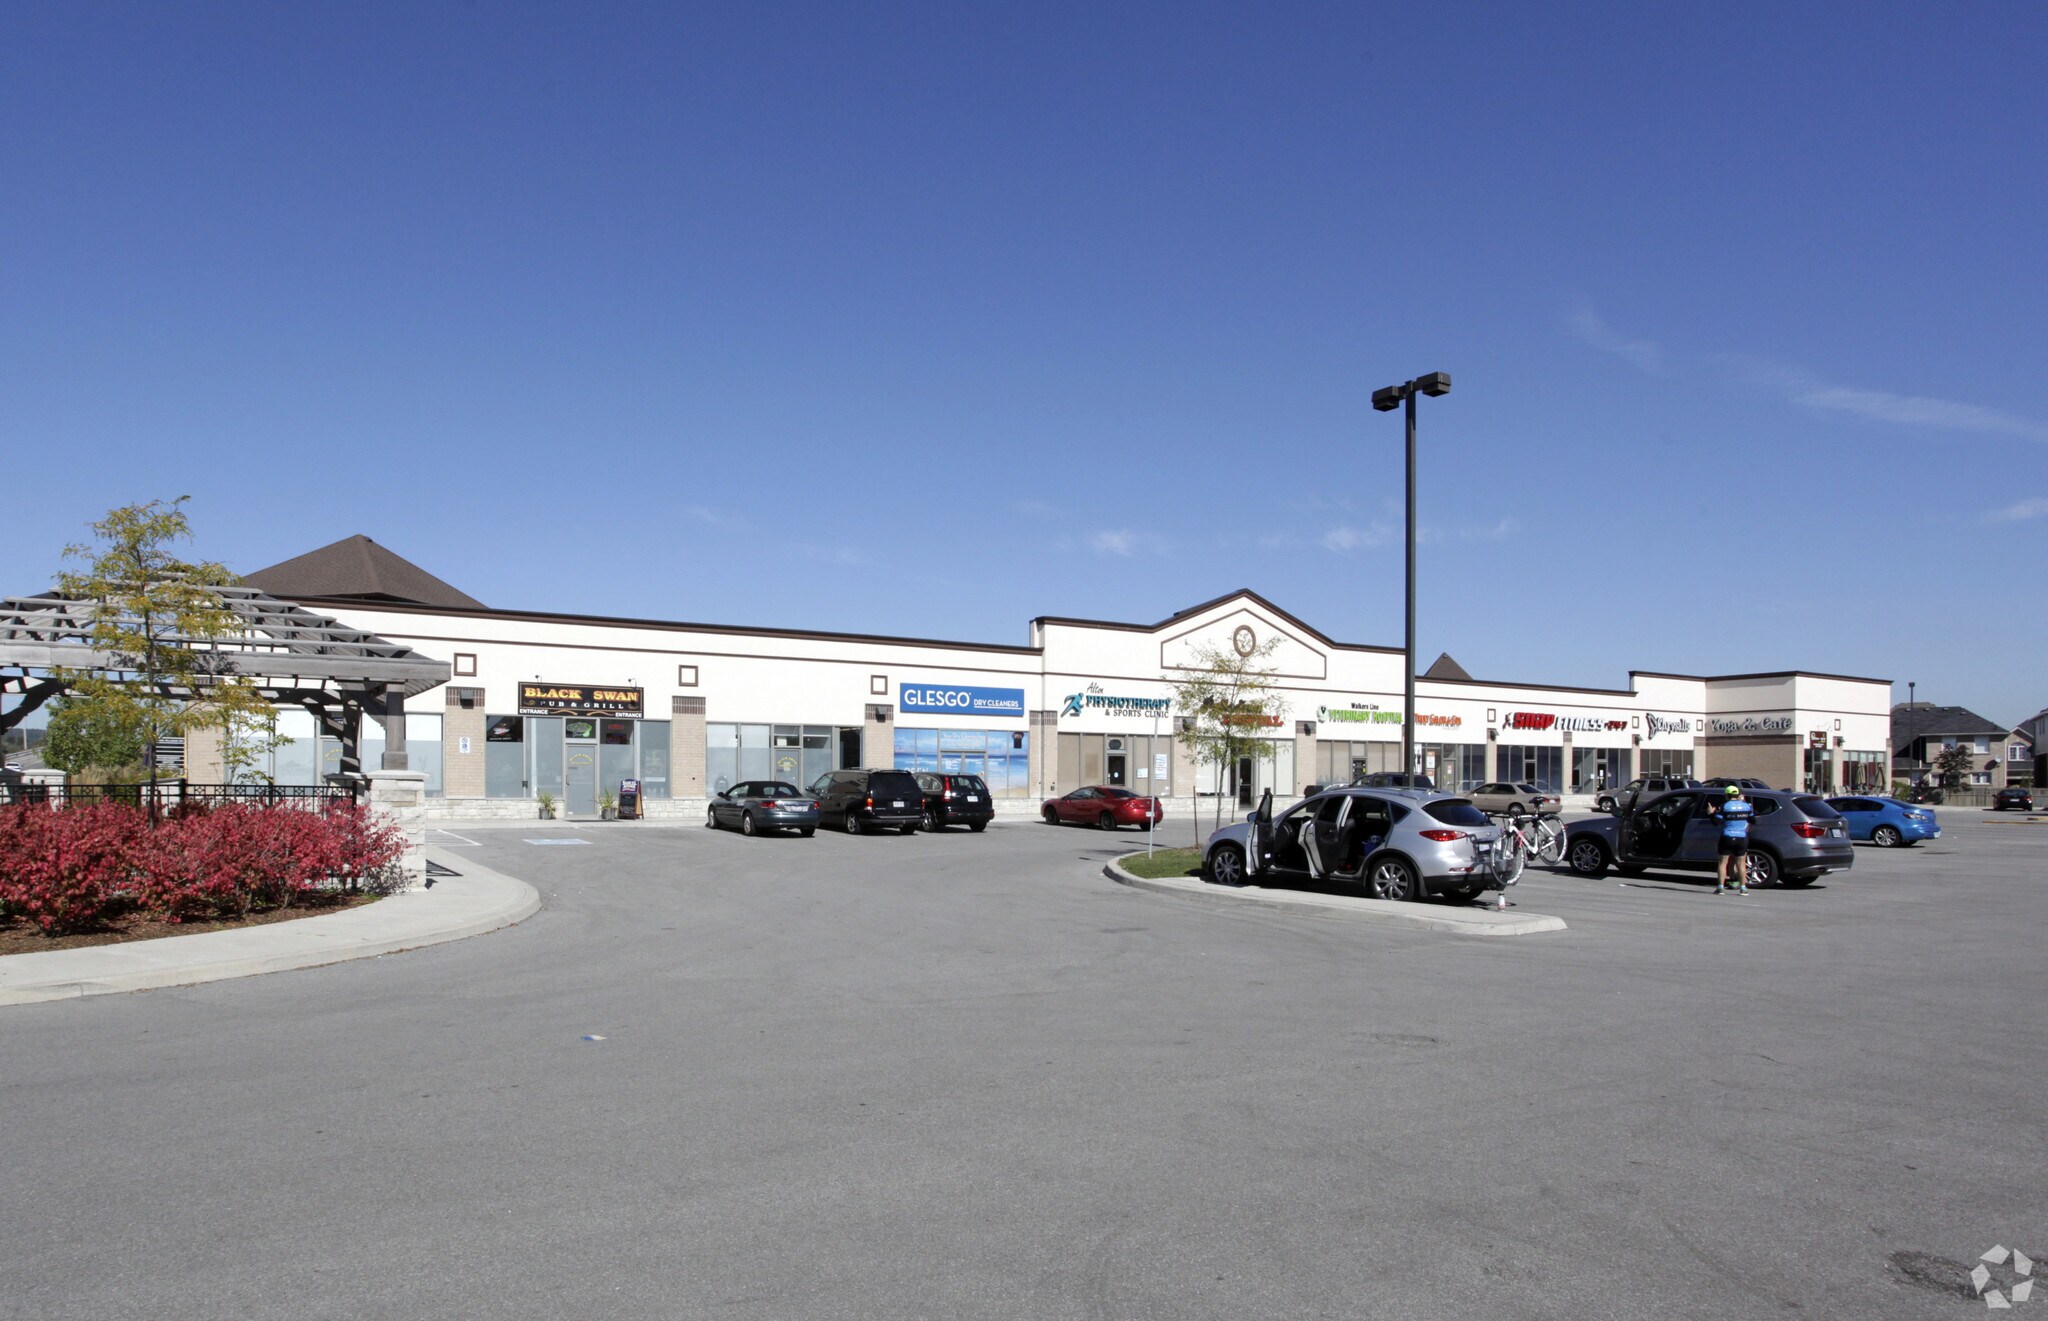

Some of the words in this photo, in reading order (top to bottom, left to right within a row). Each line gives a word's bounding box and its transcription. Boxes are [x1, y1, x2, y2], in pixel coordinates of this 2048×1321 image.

[524, 687, 583, 700] BLACK
[593, 690, 640, 702] SWAN
[904, 689, 971, 707] GLESGO
[540, 700, 565, 708] PUB
[583, 702, 624, 710] GRILL
[987, 699, 1019, 708] CLEANERS
[1086, 695, 1171, 710] PHYSIOTHERAPY
[1351, 702, 1369, 710] Walkers
[1113, 709, 1142, 717] SPORTS
[1144, 710, 1169, 718] CLINIC
[1710, 719, 1740, 733] Yoga
[1742, 718, 1757, 731] &
